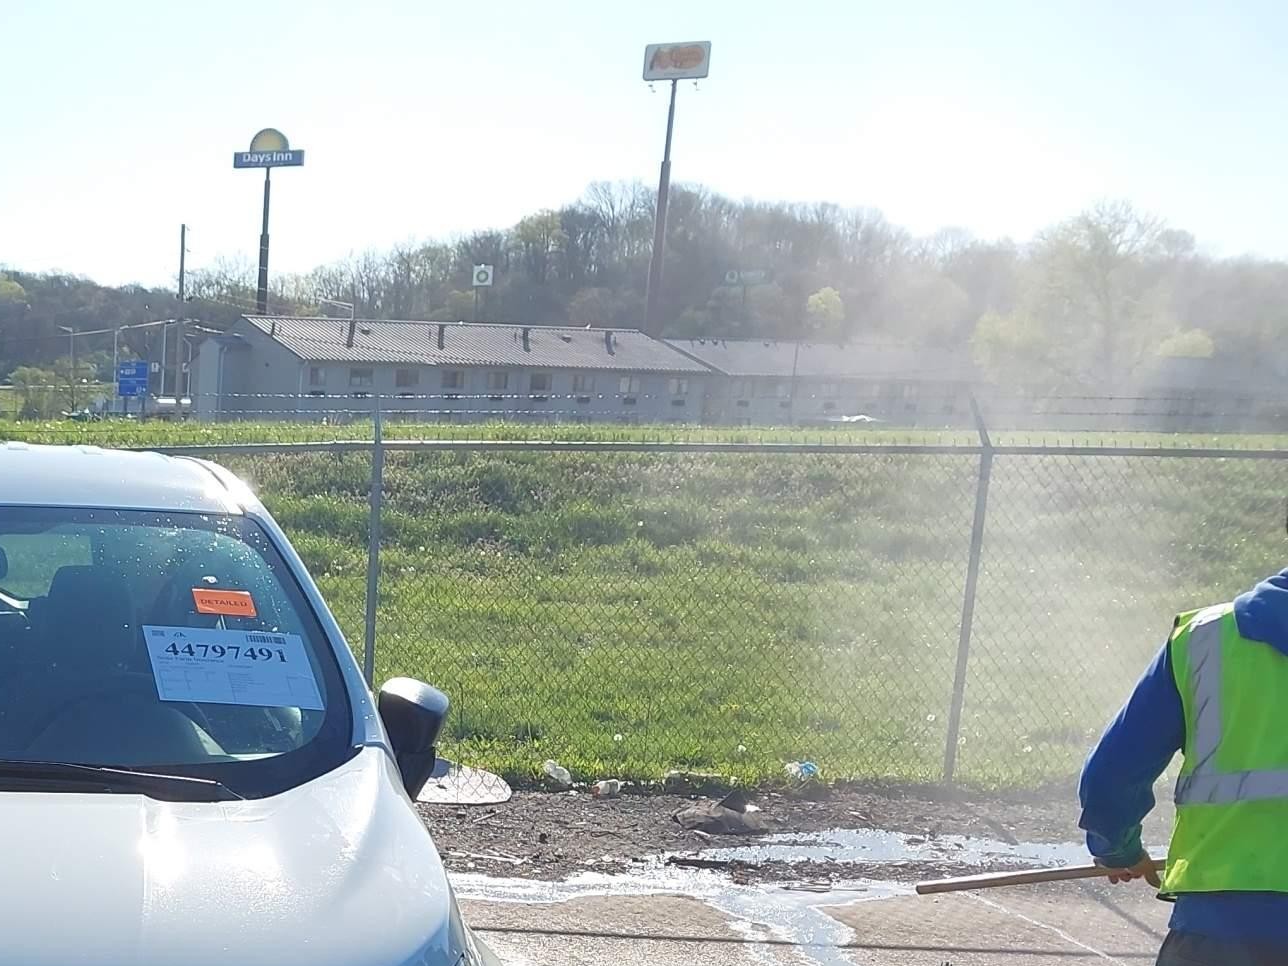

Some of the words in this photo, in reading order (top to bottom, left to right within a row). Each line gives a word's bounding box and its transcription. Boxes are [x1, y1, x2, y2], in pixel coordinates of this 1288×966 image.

[242, 152, 272, 163] Days
[273, 151, 292, 162] Inn
[200, 599, 248, 607] DETAILED
[165, 642, 287, 663] 44797491
